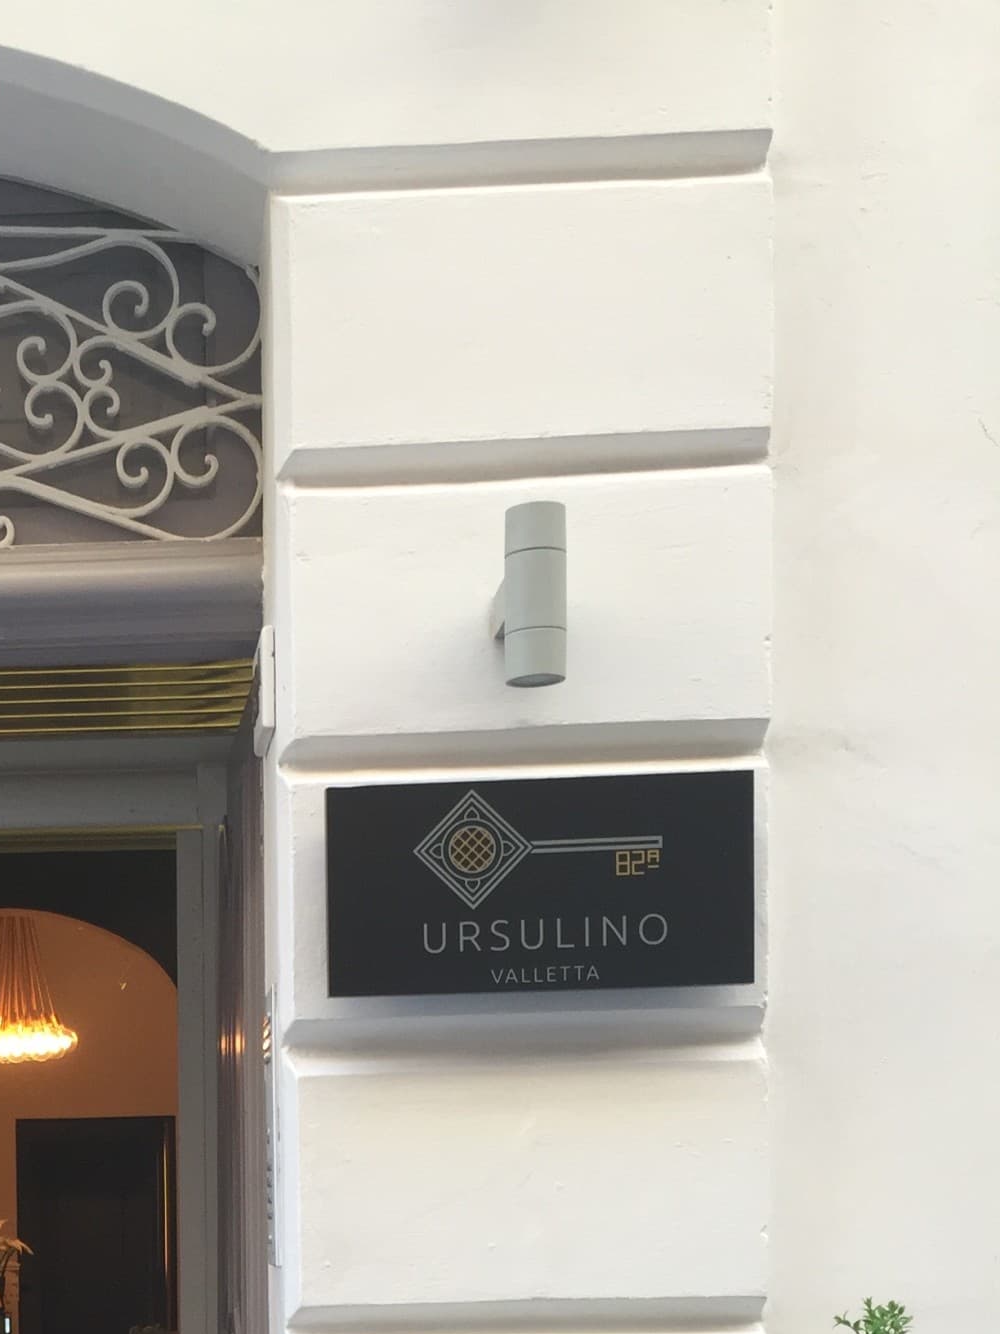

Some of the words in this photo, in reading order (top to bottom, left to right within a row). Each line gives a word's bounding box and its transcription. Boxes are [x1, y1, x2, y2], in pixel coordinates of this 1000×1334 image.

[615, 849, 660, 876] 82A
[423, 913, 668, 954] URSULINO
[491, 965, 600, 984] VALLETTA
